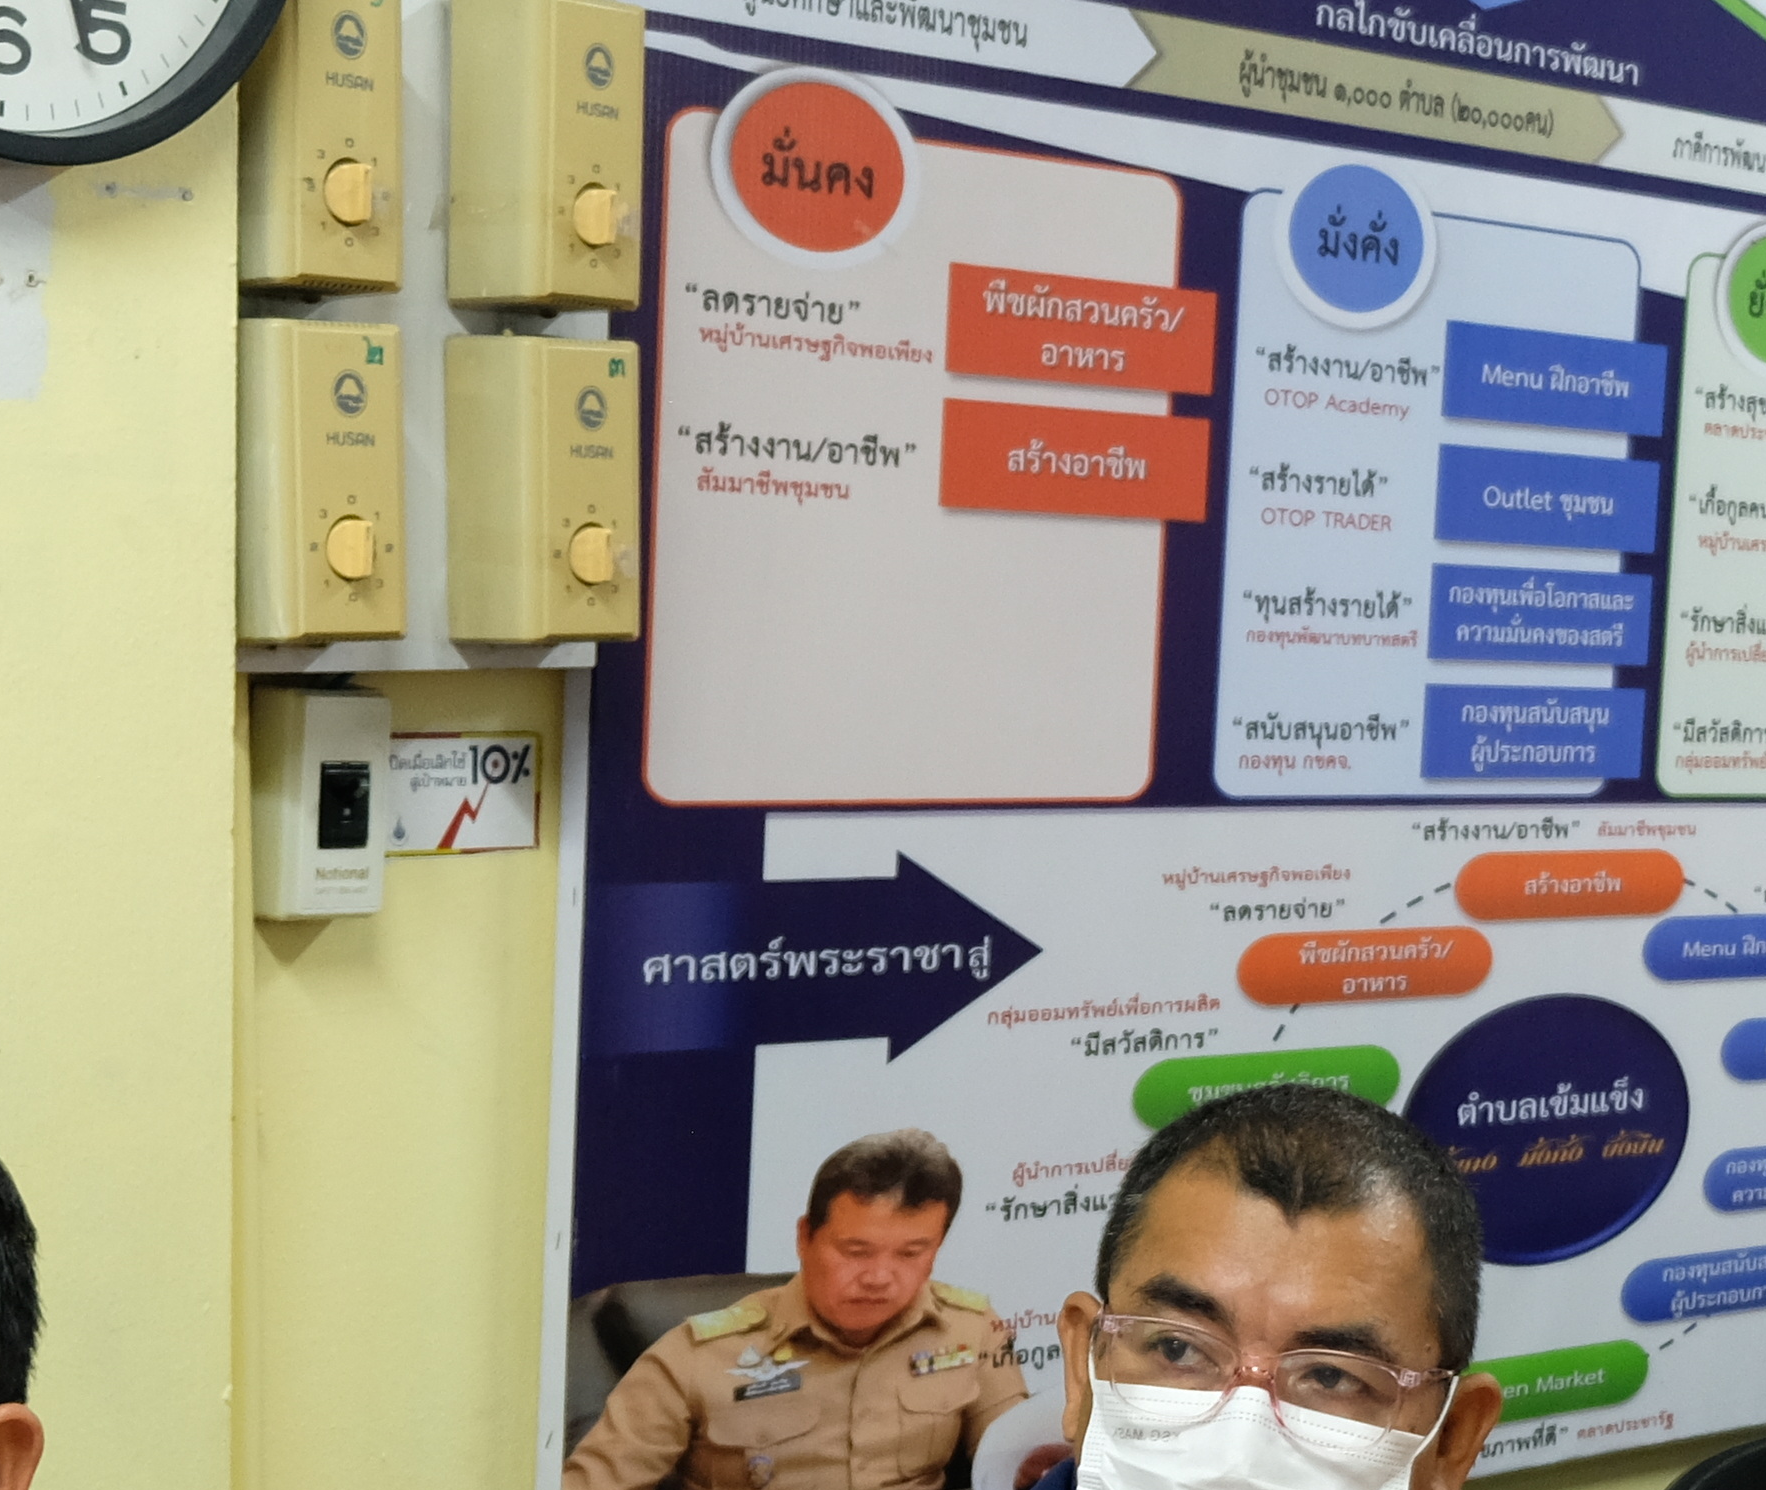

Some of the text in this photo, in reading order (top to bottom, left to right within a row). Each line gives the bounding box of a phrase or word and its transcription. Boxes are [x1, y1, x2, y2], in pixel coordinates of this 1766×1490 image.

[1316, 0, 1640, 87] กลไกขับเคลื่อนการพัฒนา
[326, 71, 374, 91] HUSAN
[1239, 48, 1327, 103] ผู้นำชุมชน
[1399, 79, 1445, 119] ตำบล
[577, 101, 620, 120] HUSAN
[762, 127, 875, 200] มั่นคง
[1317, 205, 1400, 266] มั่งคั่ง
[983, 281, 1185, 333] พืชผักสวนครัว/
[1040, 341, 1125, 373] อาหาร
[1482, 364, 1630, 399] Menu ฝึกอาชีพ
[1264, 388, 1410, 421] OTOP Academy
[326, 431, 375, 448] HUSAN
[570, 444, 614, 460] HUSAN
[1007, 438, 1148, 481] สร้างอาชีพ
[1260, 507, 1392, 531] OTOP TRADER
[1482, 486, 1614, 521] Outlet ชุมชน
[1461, 699, 1610, 735] กองทุนสนับสนุน
[469, 745, 530, 785] 10%
[1471, 736, 1596, 773] ผู้ประกอบการ
[1524, 871, 1622, 896] สร้างอาชีพ
[1682, 939, 1736, 959] Menu
[1342, 972, 1408, 995] อาหาร
[1457, 1075, 1645, 1127] ตำบลเข้มแข็ง
[1536, 1368, 1606, 1394] Market
